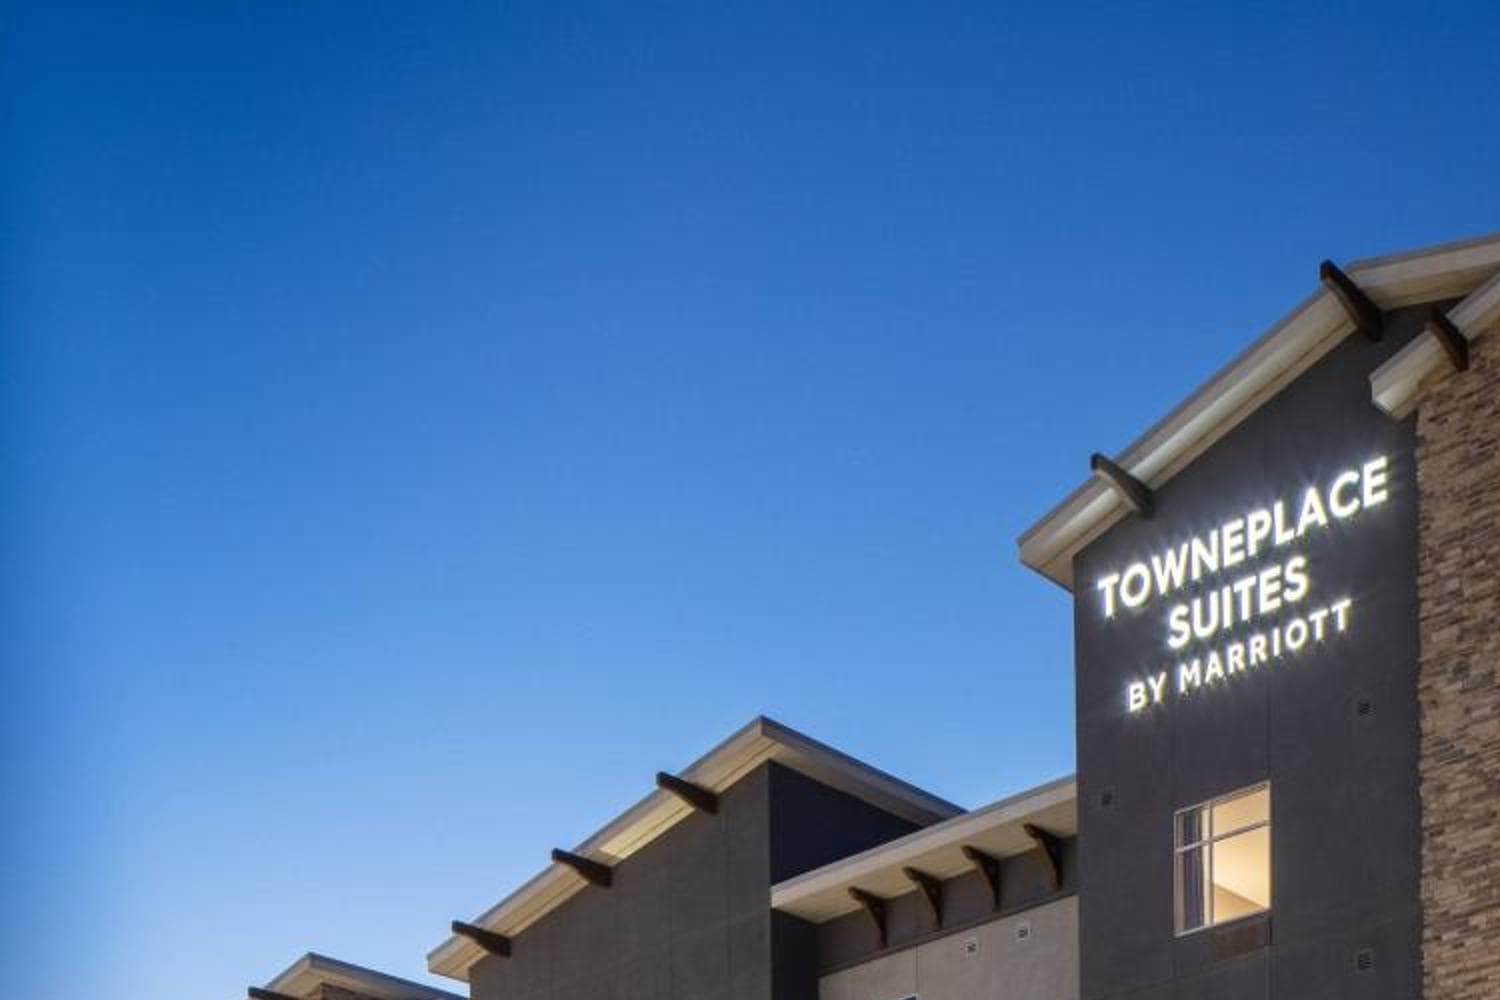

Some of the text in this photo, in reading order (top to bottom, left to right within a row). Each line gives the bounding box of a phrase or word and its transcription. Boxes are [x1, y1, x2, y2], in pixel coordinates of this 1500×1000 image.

[1097, 456, 1388, 617] TOWNEPLACE
[1128, 600, 1352, 711] BY MARRIOTT
[1167, 557, 1308, 648] SUITES
